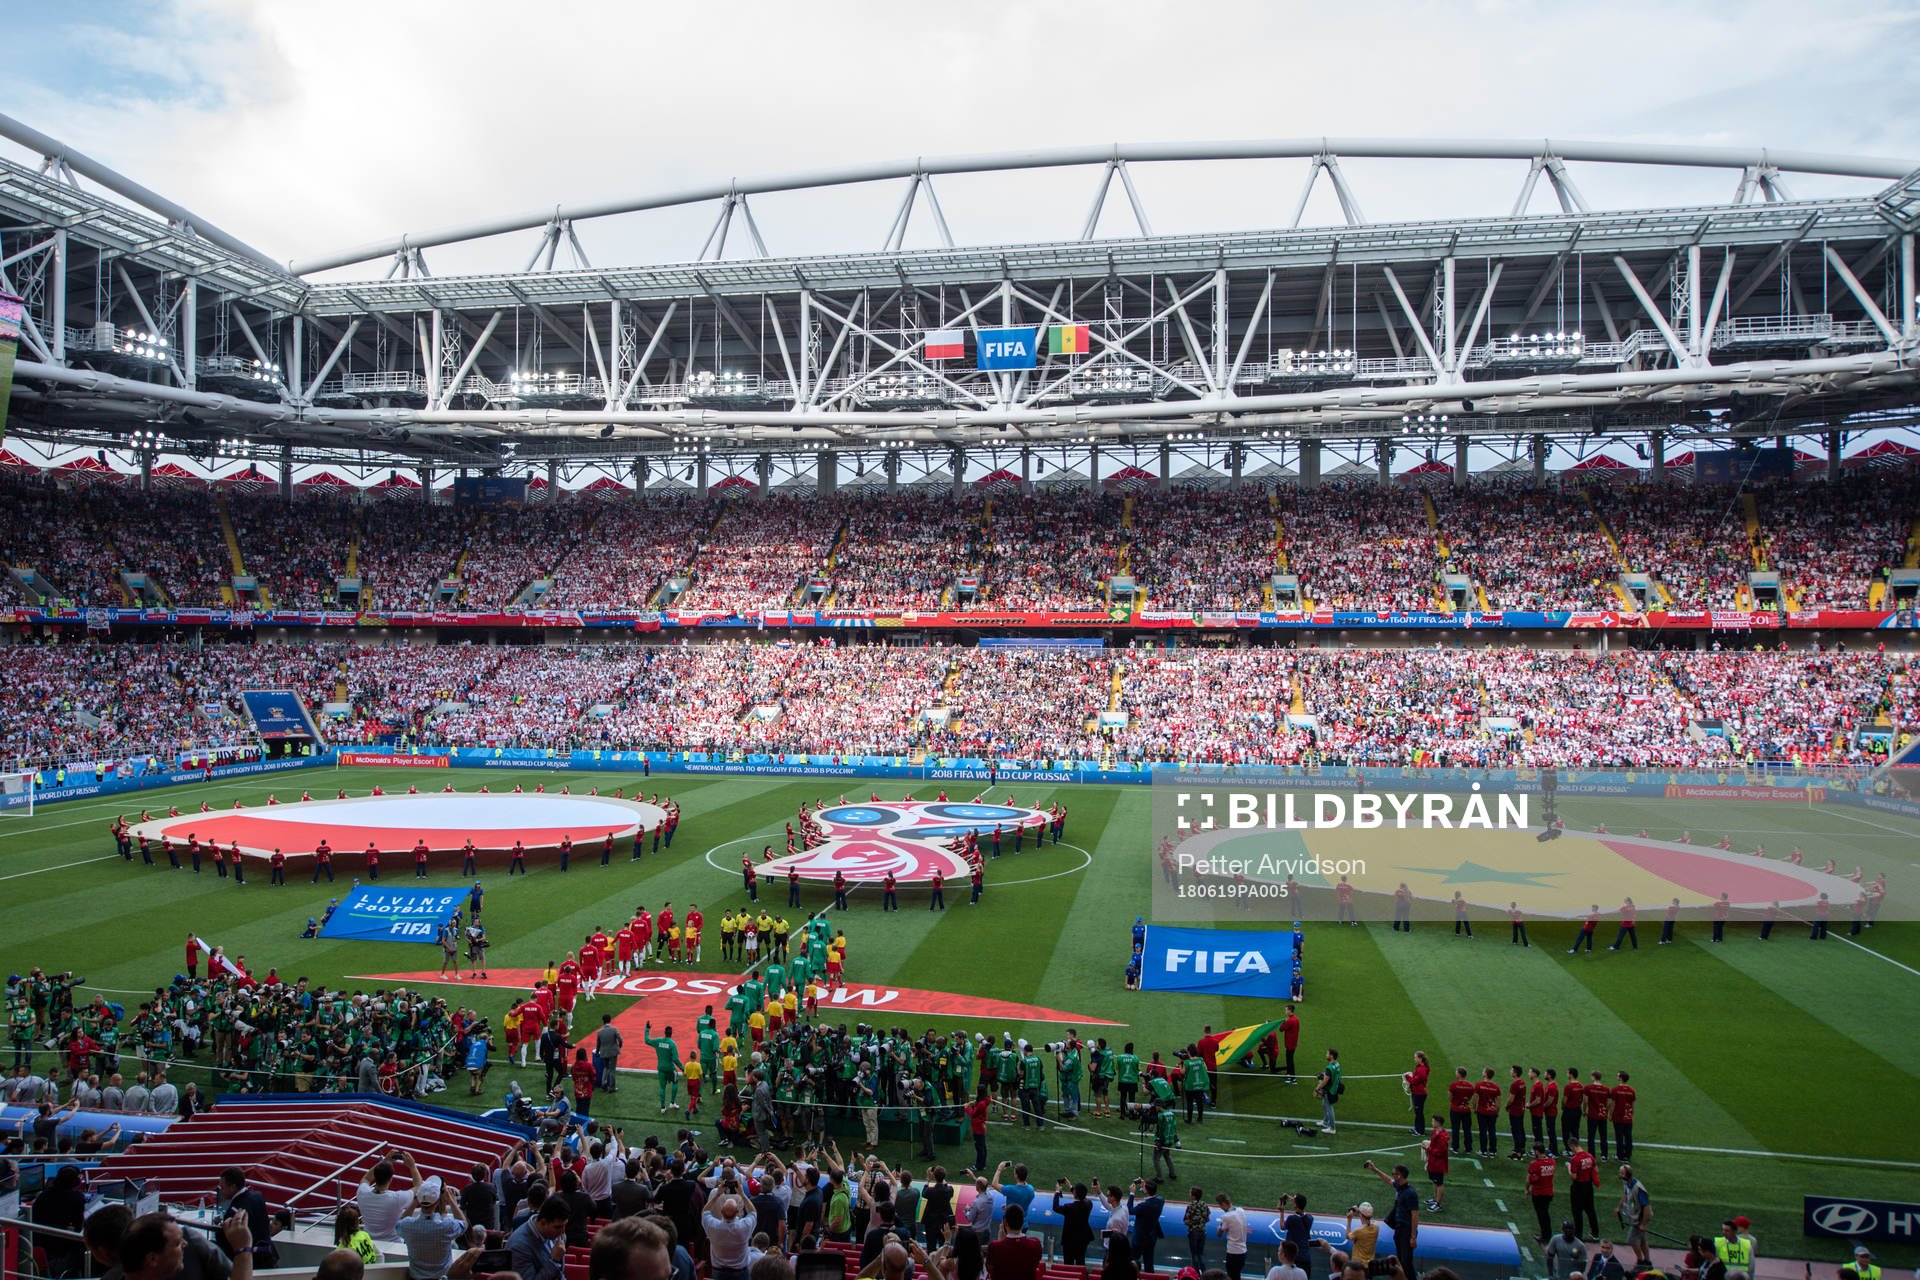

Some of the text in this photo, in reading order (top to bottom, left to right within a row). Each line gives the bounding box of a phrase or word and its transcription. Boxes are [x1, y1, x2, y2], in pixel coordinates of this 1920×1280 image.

[985, 341, 1027, 358] FIFA
[1363, 616, 1376, 624] ПО
[1418, 616, 1437, 624] FIFA
[355, 756, 391, 765] McDonald's
[392, 757, 413, 766] Player
[484, 759, 499, 767] 2018
[499, 759, 512, 767] FIFA
[534, 760, 546, 768] CUP
[756, 765, 788, 773] ФУТБОЛУ
[803, 766, 819, 774] 2018
[931, 770, 953, 778] 2018
[954, 770, 974, 779] FIFA
[975, 771, 1010, 780] WOLD
[1011, 772, 1032, 780] CUP
[1174, 776, 1220, 784] ЧЕМПИОНАТ
[1221, 777, 1244, 785] МИРА
[1257, 778, 1294, 786] ФУТБОЛУ
[1513, 783, 1531, 791] 2018
[1556, 784, 1579, 792] ORLD
[1685, 787, 1804, 798] McDonald's Player Escort
[39, 790, 62, 800] WORLD
[62, 789, 75, 798] CUP
[360, 894, 454, 905] LIVING
[353, 902, 445, 914] FOOTBALL
[389, 922, 432, 936] FIFA
[1165, 948, 1271, 974] FIFA
